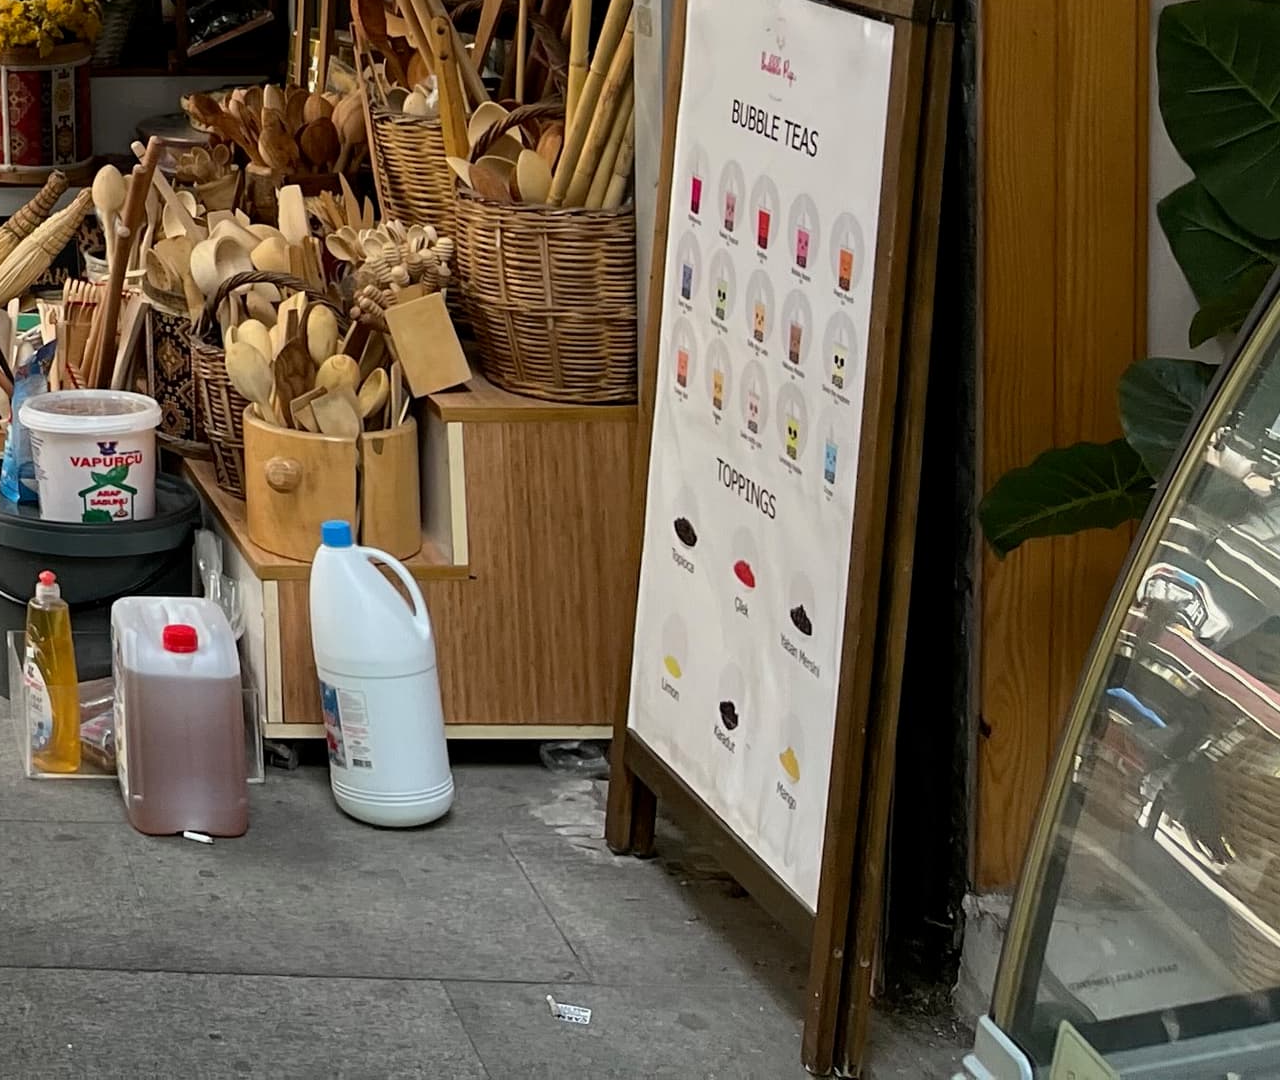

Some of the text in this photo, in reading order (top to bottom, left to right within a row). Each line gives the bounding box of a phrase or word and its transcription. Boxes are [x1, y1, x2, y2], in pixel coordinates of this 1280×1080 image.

[731, 98, 819, 157] BUBBLE TEAS
[70, 454, 143, 469] VAPURCU
[716, 457, 777, 520] TOPPINGS
[661, 676, 680, 702] Limon
[713, 724, 736, 754] Karadut
[776, 780, 797, 811] Mango
